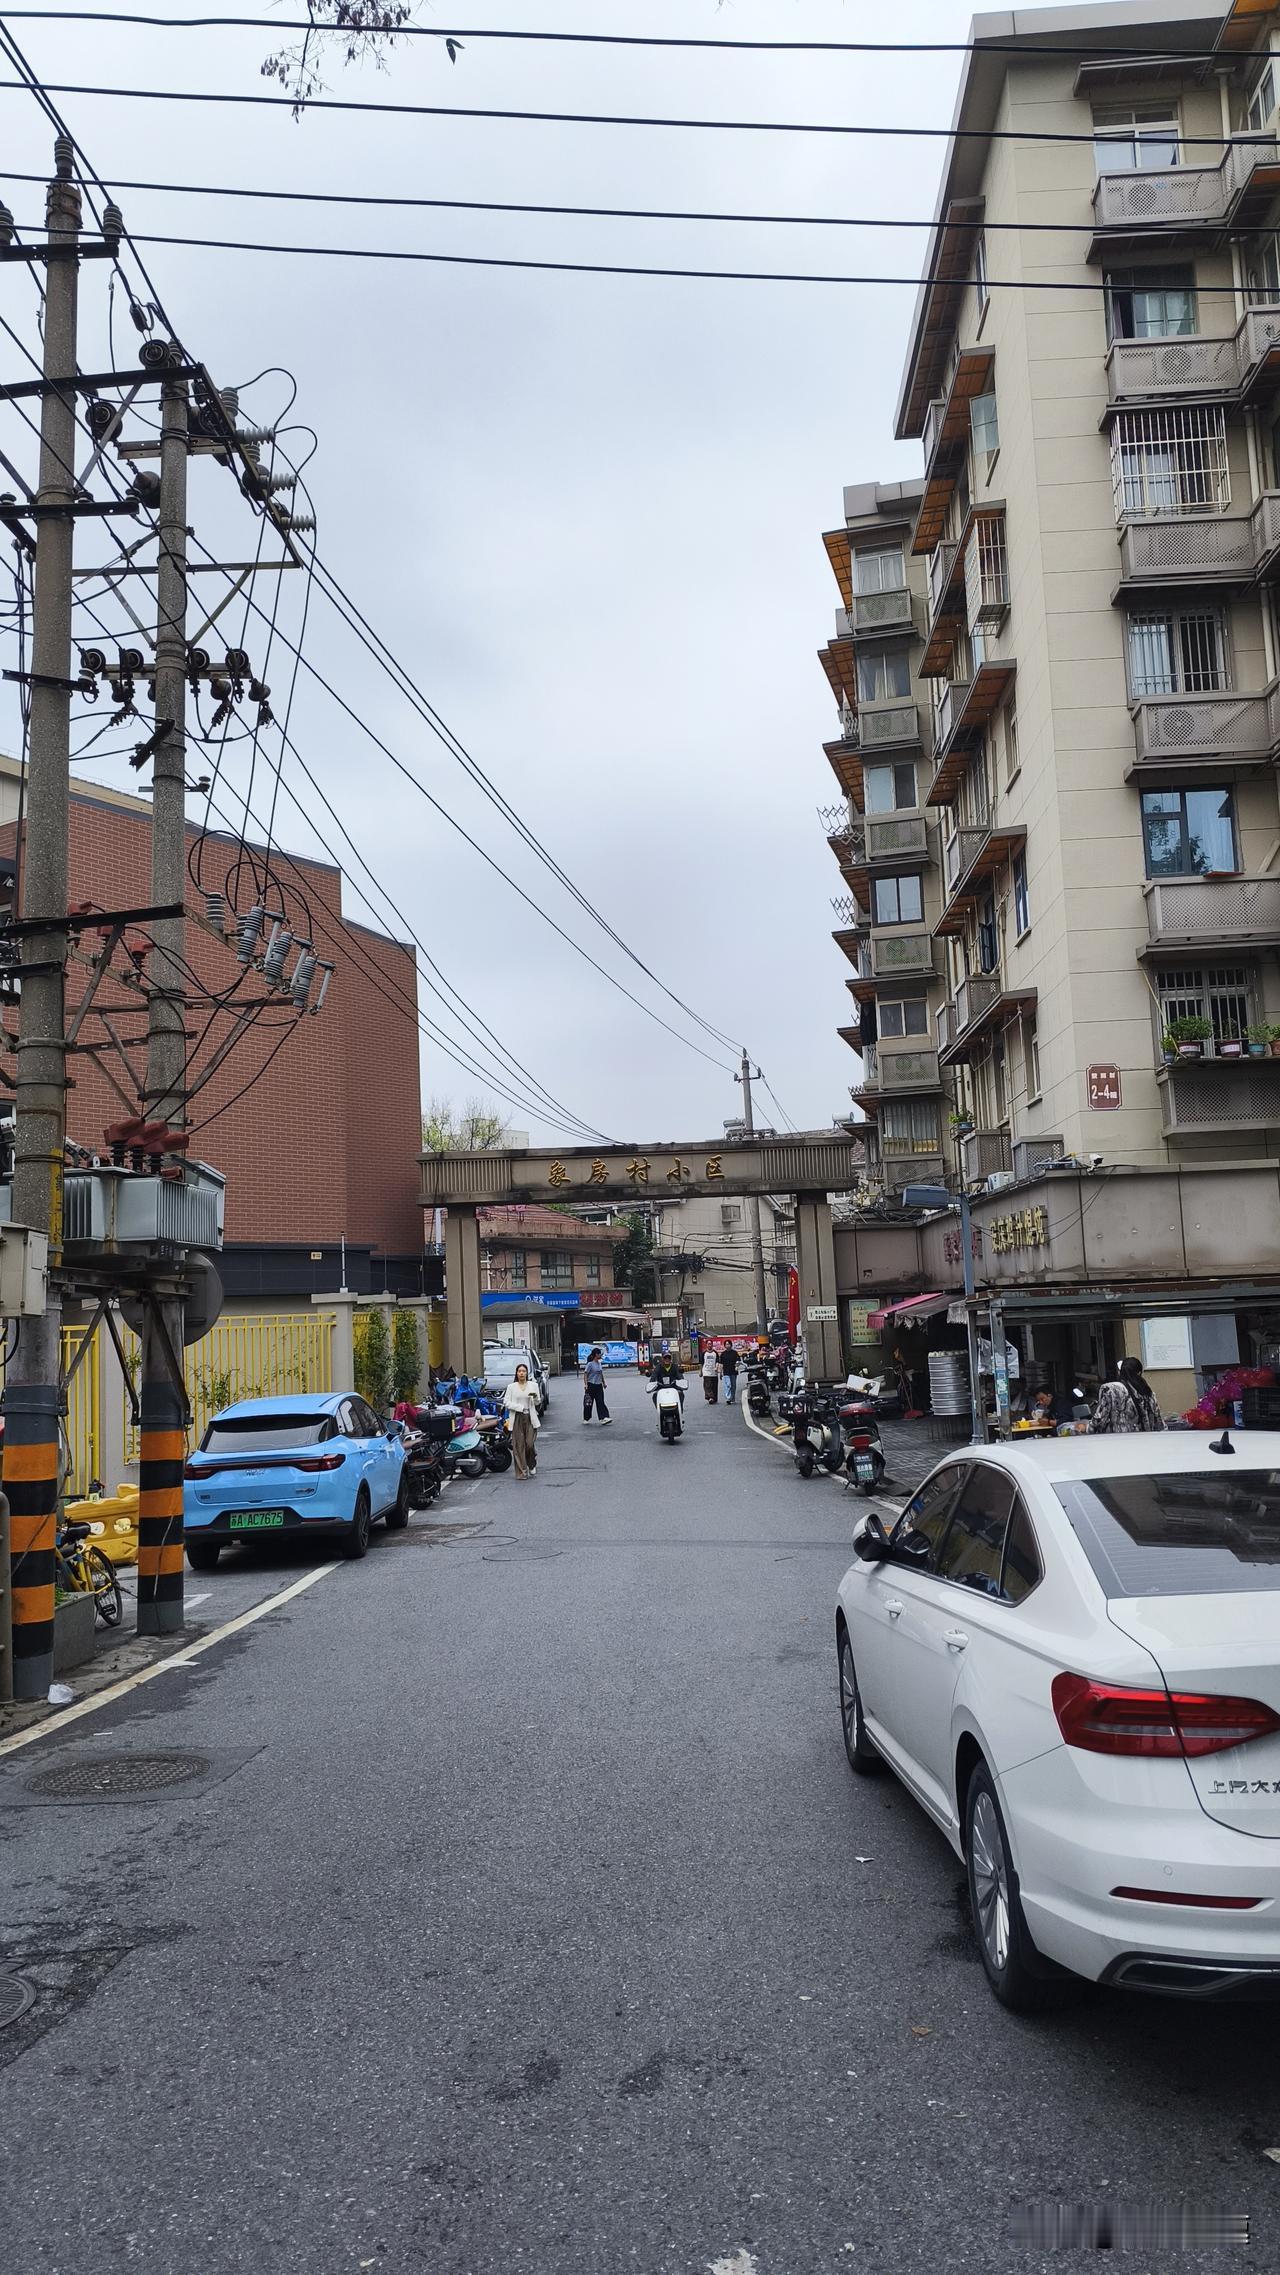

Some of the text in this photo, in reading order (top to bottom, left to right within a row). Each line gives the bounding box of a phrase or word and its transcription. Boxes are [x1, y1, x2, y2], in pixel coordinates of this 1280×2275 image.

[548, 1154, 725, 1187] 象房村小区
[247, 1512, 283, 1526] AC7675
